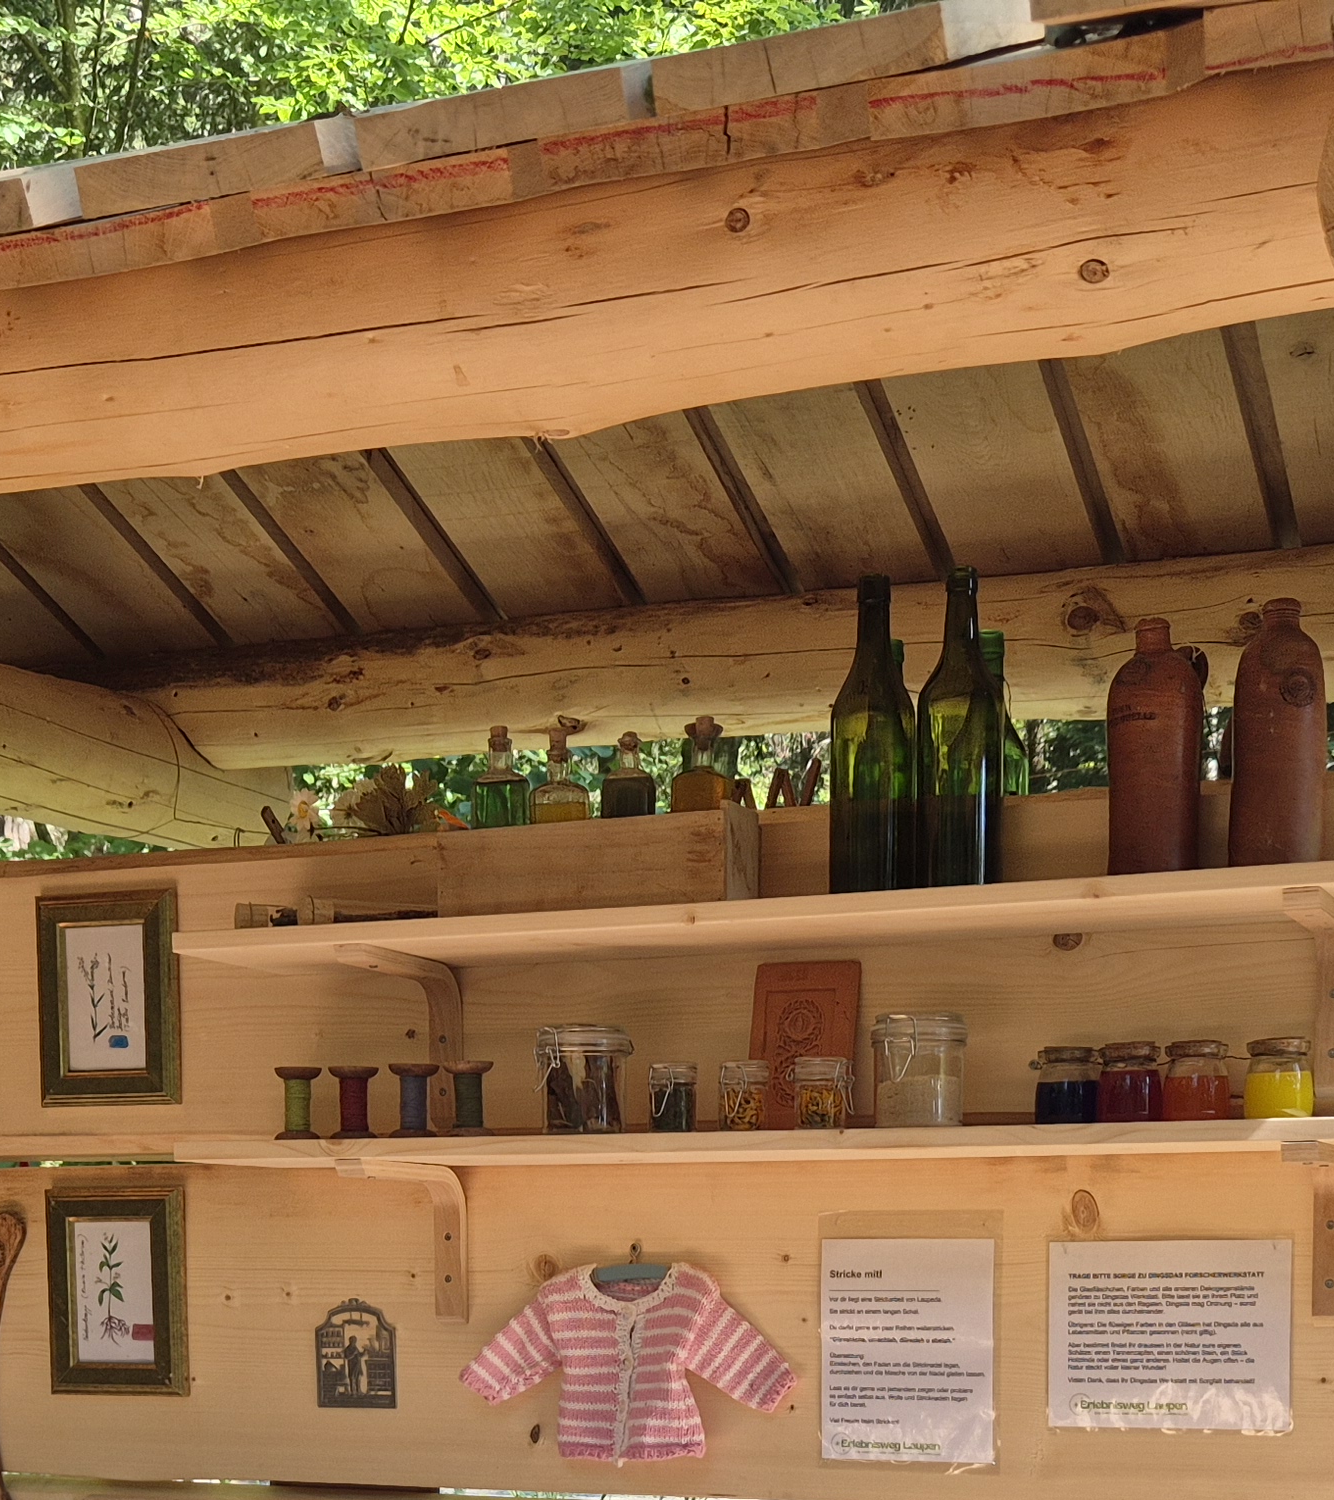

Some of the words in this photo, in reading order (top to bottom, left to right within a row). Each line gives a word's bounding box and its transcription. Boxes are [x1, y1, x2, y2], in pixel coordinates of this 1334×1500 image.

[829, 1270, 862, 1279] Stricke
[1080, 1400, 1144, 1412] Erlebnisweg
[1147, 1401, 1188, 1412] Laupen
[841, 1439, 900, 1452] Erlebnisweg
[903, 1441, 941, 1453] Laupen
